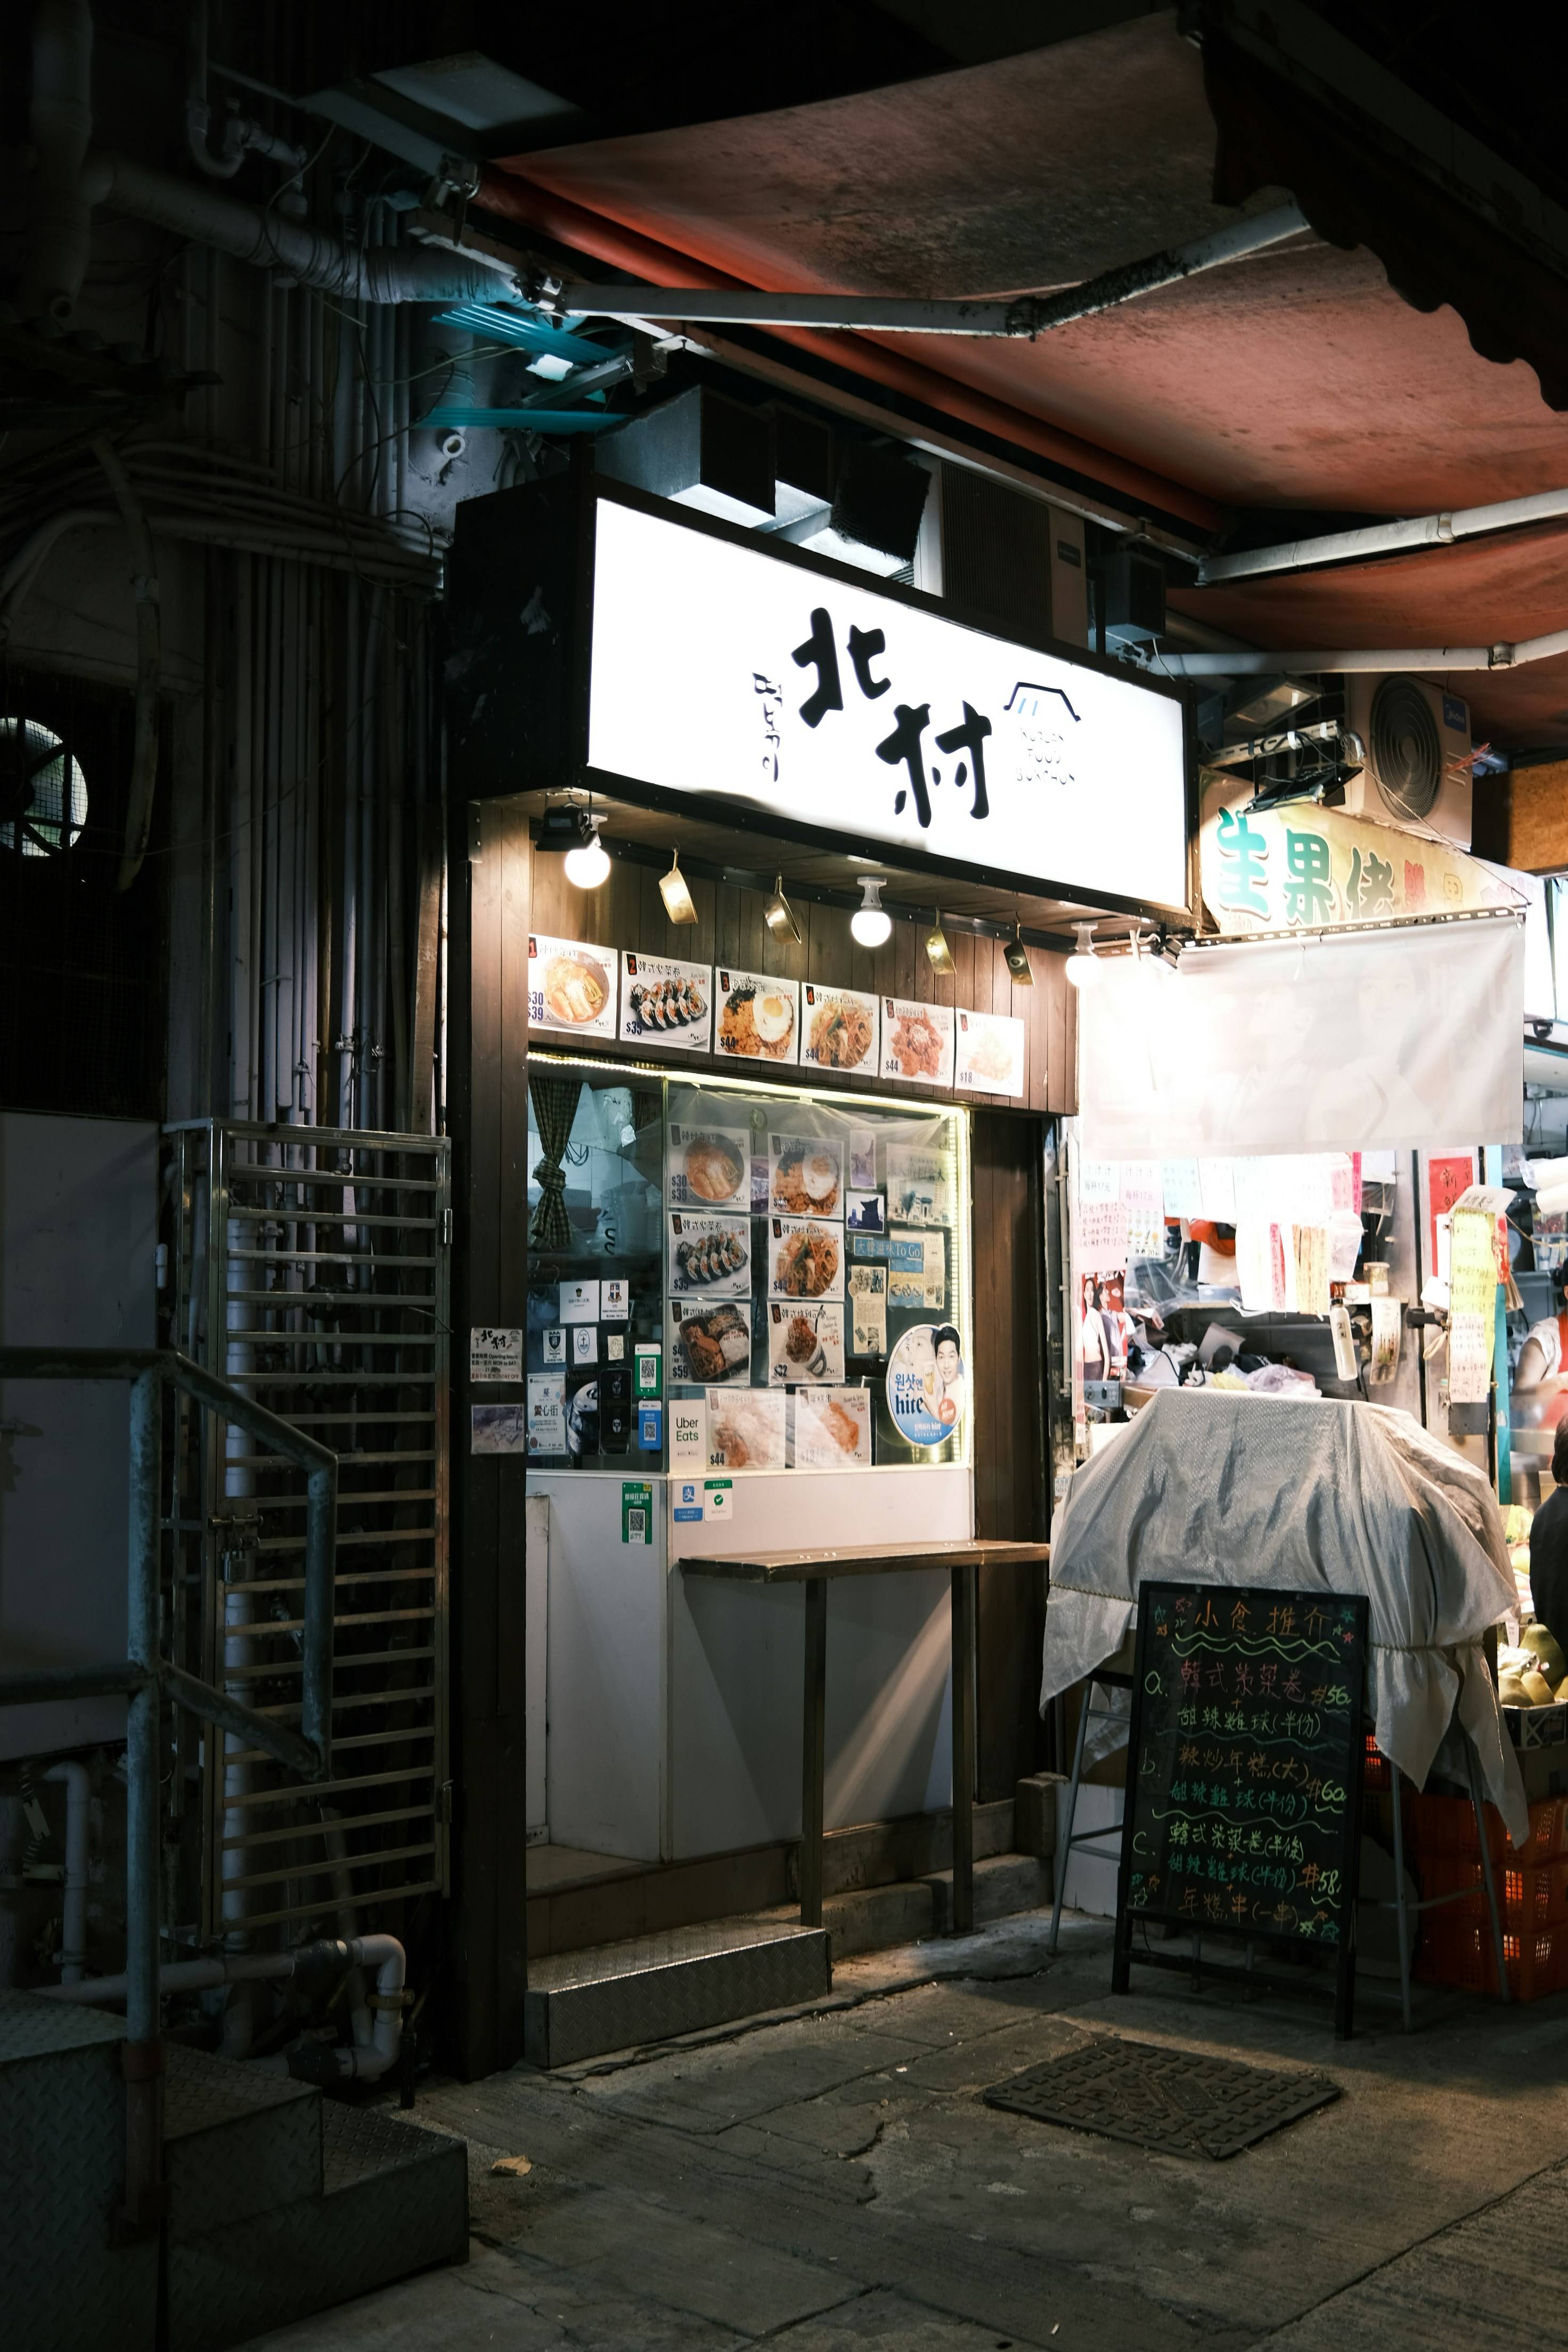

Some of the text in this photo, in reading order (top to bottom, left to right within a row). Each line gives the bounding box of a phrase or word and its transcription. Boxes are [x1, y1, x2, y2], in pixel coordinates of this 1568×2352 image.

[791, 607, 992, 829] 北村
[626, 1020, 642, 1035] $35
[805, 1048, 819, 1061] $44
[886, 1059, 899, 1072] $44
[960, 1072, 973, 1083] $18
[671, 1174, 687, 1187] $30
[671, 1188, 687, 1202] $39
[857, 1239, 920, 1257] 大韓滋味 To Go
[481, 1329, 506, 1350] 北村
[672, 1366, 688, 1378] $59
[895, 1373, 923, 1392] 원샷엔
[895, 1393, 924, 1415] hite
[941, 1408, 954, 1420] New
[676, 1417, 699, 1428] Uber
[676, 1430, 699, 1441] Eats
[710, 1452, 725, 1466] $44
[1195, 1599, 1333, 1643] 小食推介
